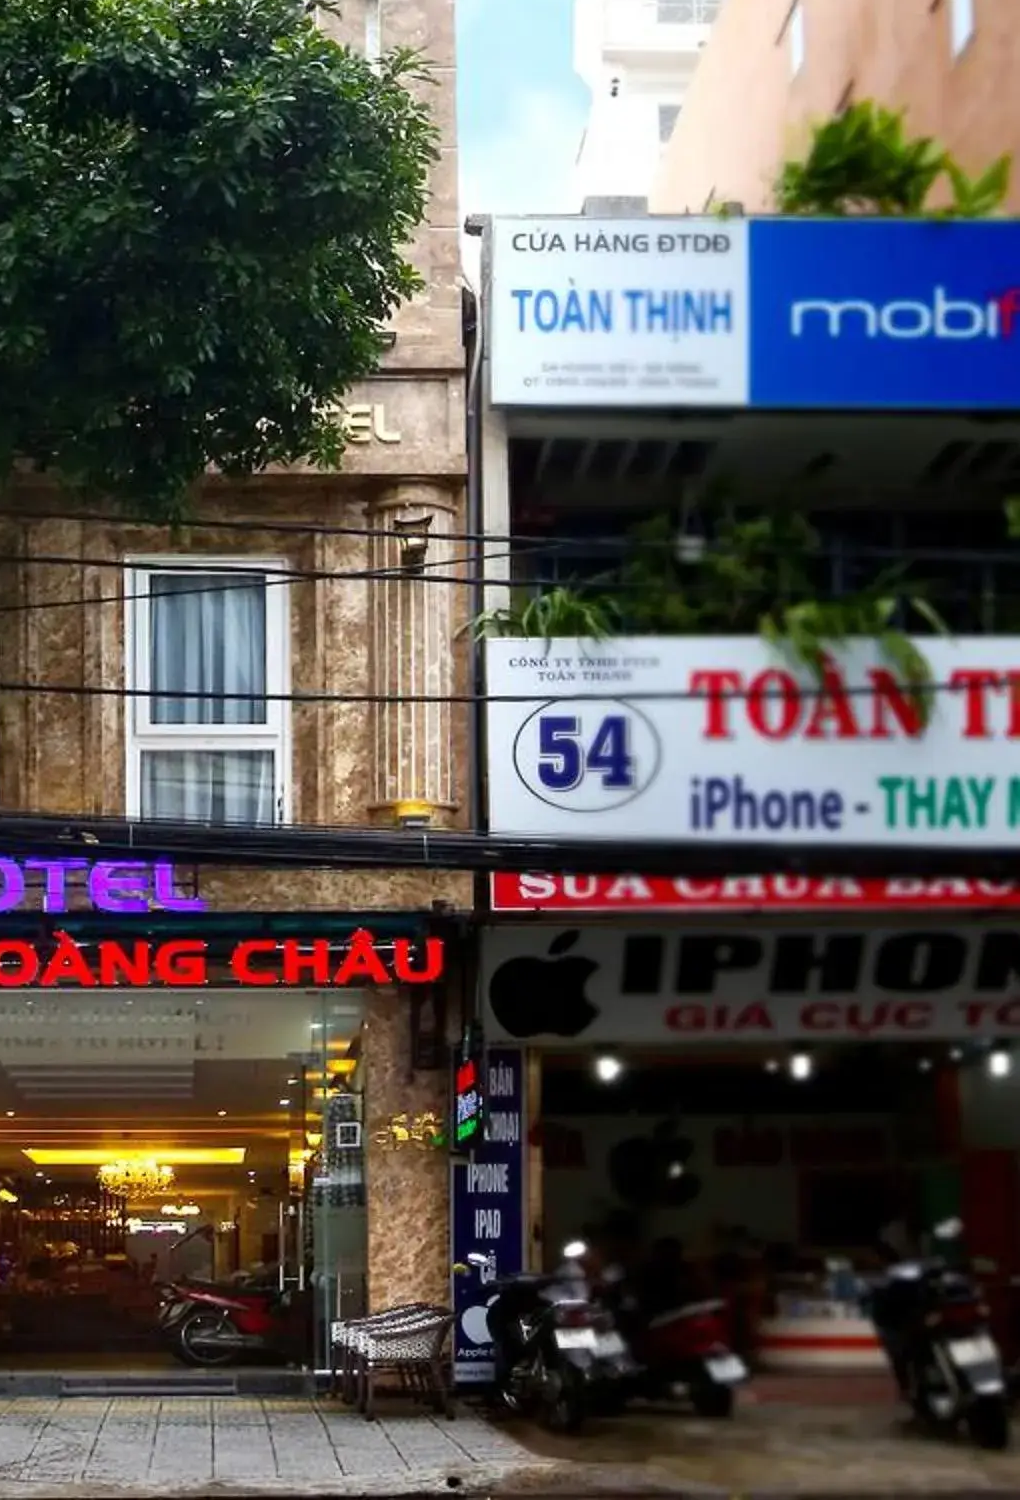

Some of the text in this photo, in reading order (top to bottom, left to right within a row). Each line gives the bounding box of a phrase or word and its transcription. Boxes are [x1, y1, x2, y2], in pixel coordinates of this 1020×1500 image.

[511, 277, 733, 344] TOÀN THỊNH
[537, 715, 636, 793] 54
[689, 775, 843, 830] iPhone
[878, 777, 994, 829] THAY
[231, 928, 444, 986] CHÂU
[467, 1163, 509, 1193] IPHONE
[475, 1209, 501, 1239] IPAD
